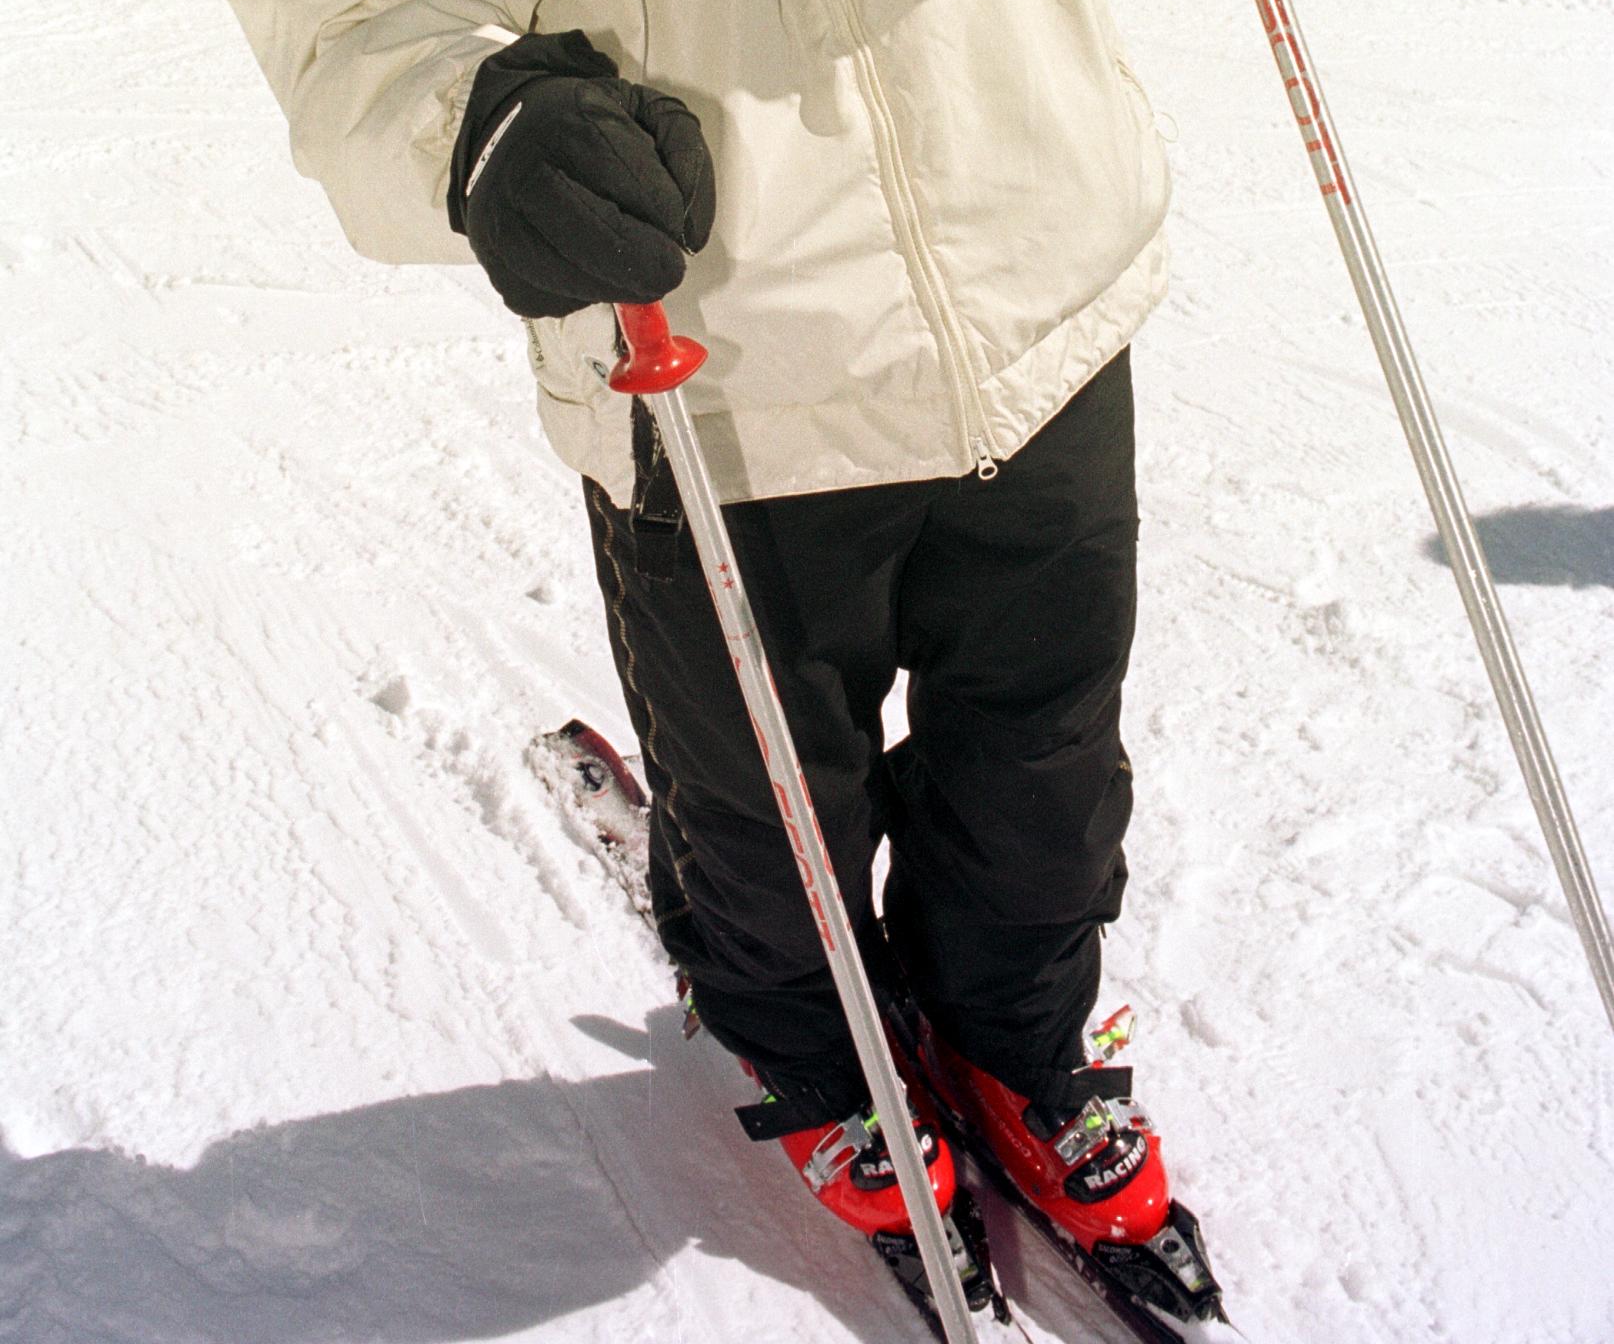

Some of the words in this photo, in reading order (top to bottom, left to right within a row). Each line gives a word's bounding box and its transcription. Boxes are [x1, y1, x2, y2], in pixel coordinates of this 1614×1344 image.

[527, 320, 543, 354] Columbi
[859, 1132, 933, 1177] RAG
[1083, 1135, 1147, 1190] RACING
